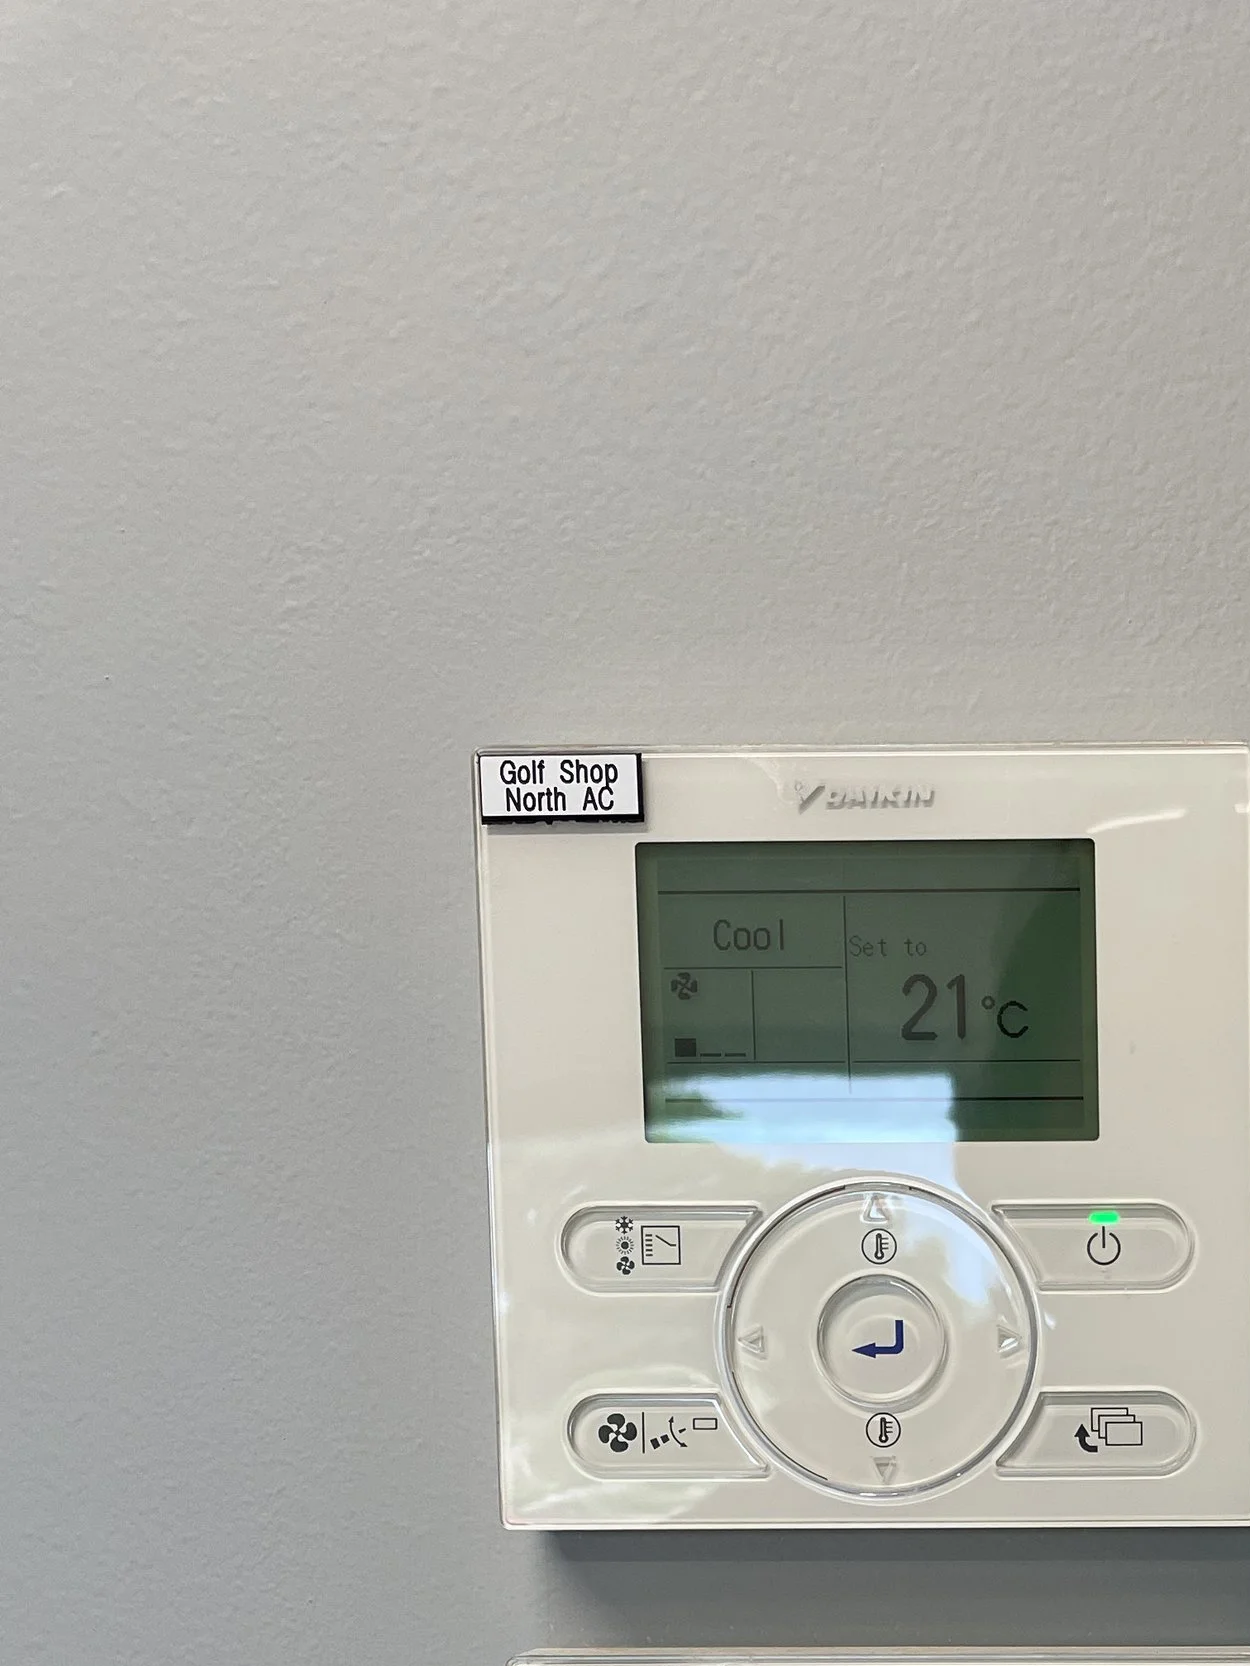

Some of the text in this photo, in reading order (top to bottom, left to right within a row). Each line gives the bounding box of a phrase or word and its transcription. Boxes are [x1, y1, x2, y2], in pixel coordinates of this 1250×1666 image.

[500, 760, 618, 792] Golf Shop
[505, 787, 614, 813] North AC
[825, 786, 935, 810] DAIKIN
[713, 919, 786, 953] Cool
[849, 936, 927, 957] Set to
